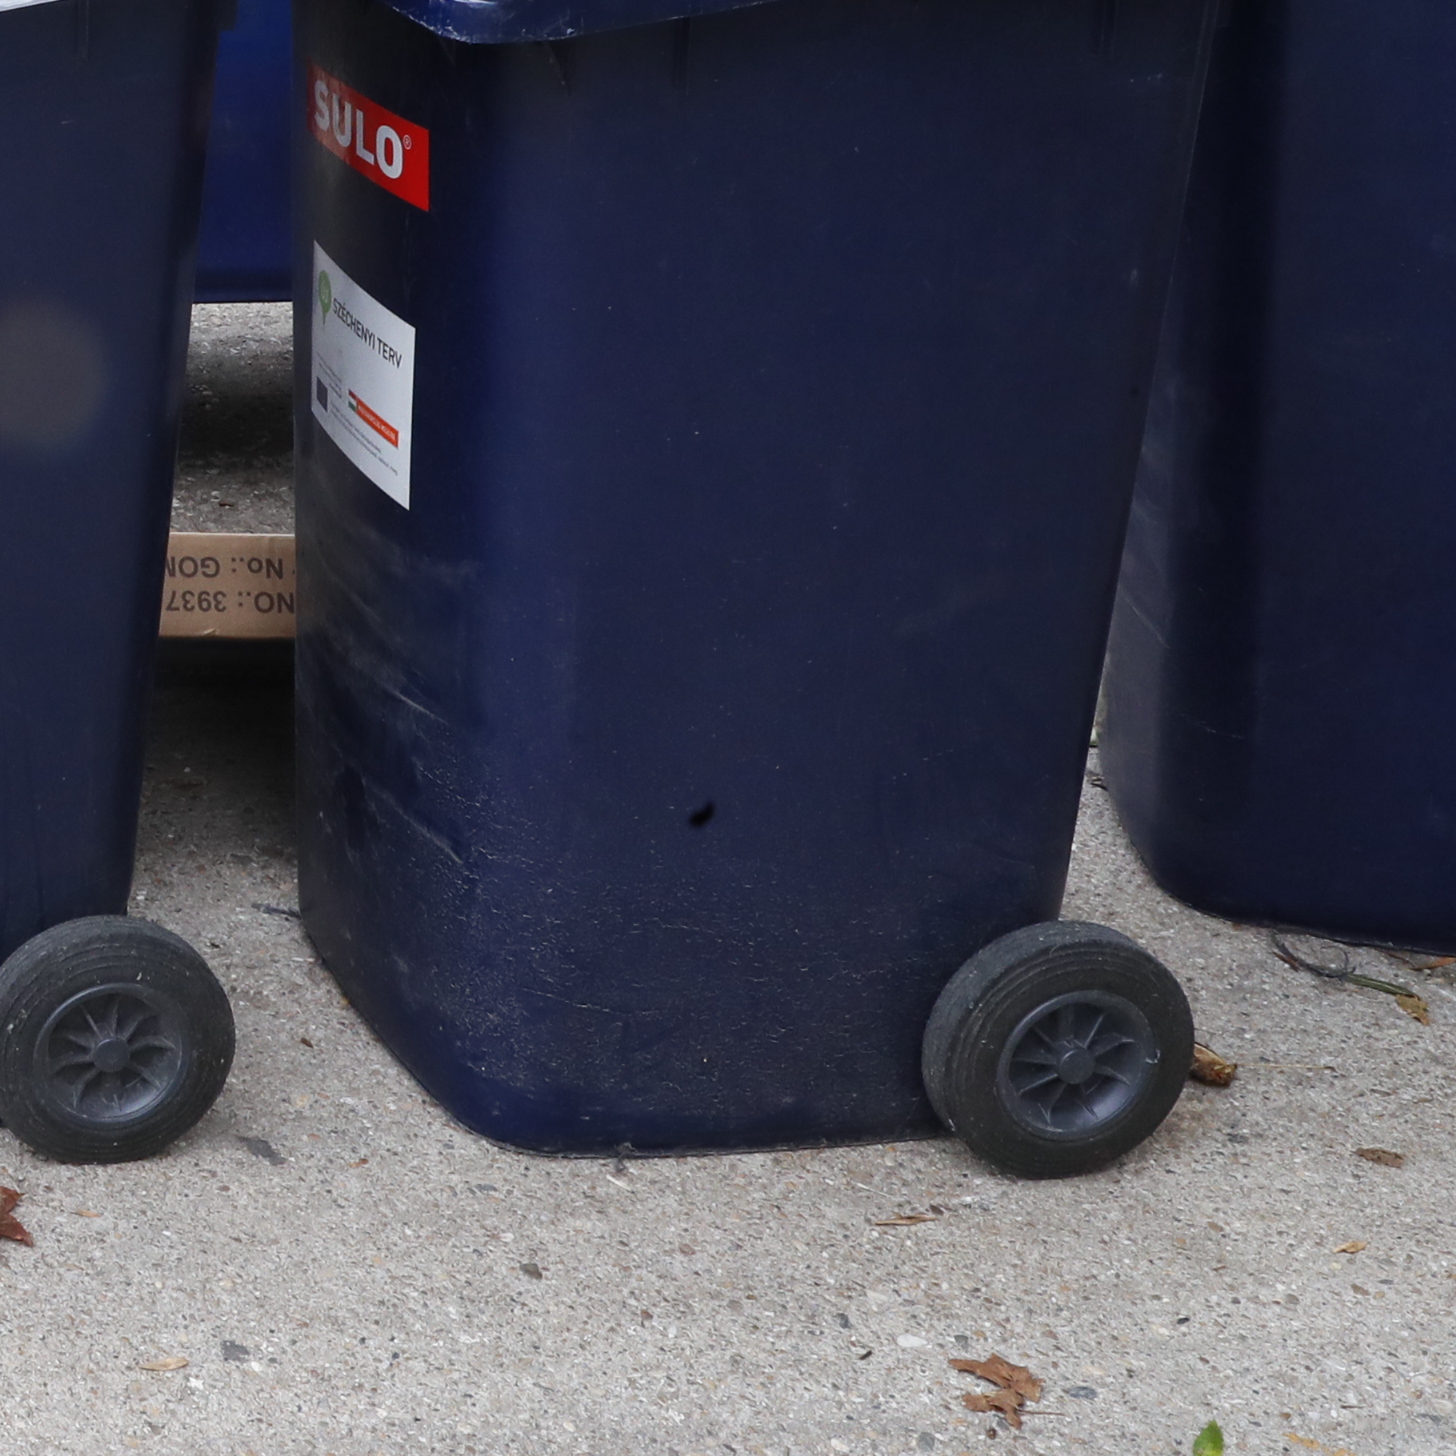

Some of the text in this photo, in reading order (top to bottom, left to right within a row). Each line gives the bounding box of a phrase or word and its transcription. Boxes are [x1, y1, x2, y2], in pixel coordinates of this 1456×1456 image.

[314, 79, 404, 180] SULO
[332, 297, 403, 370] SZÉCHENYI TERV
[165, 590, 227, 613] 3937
